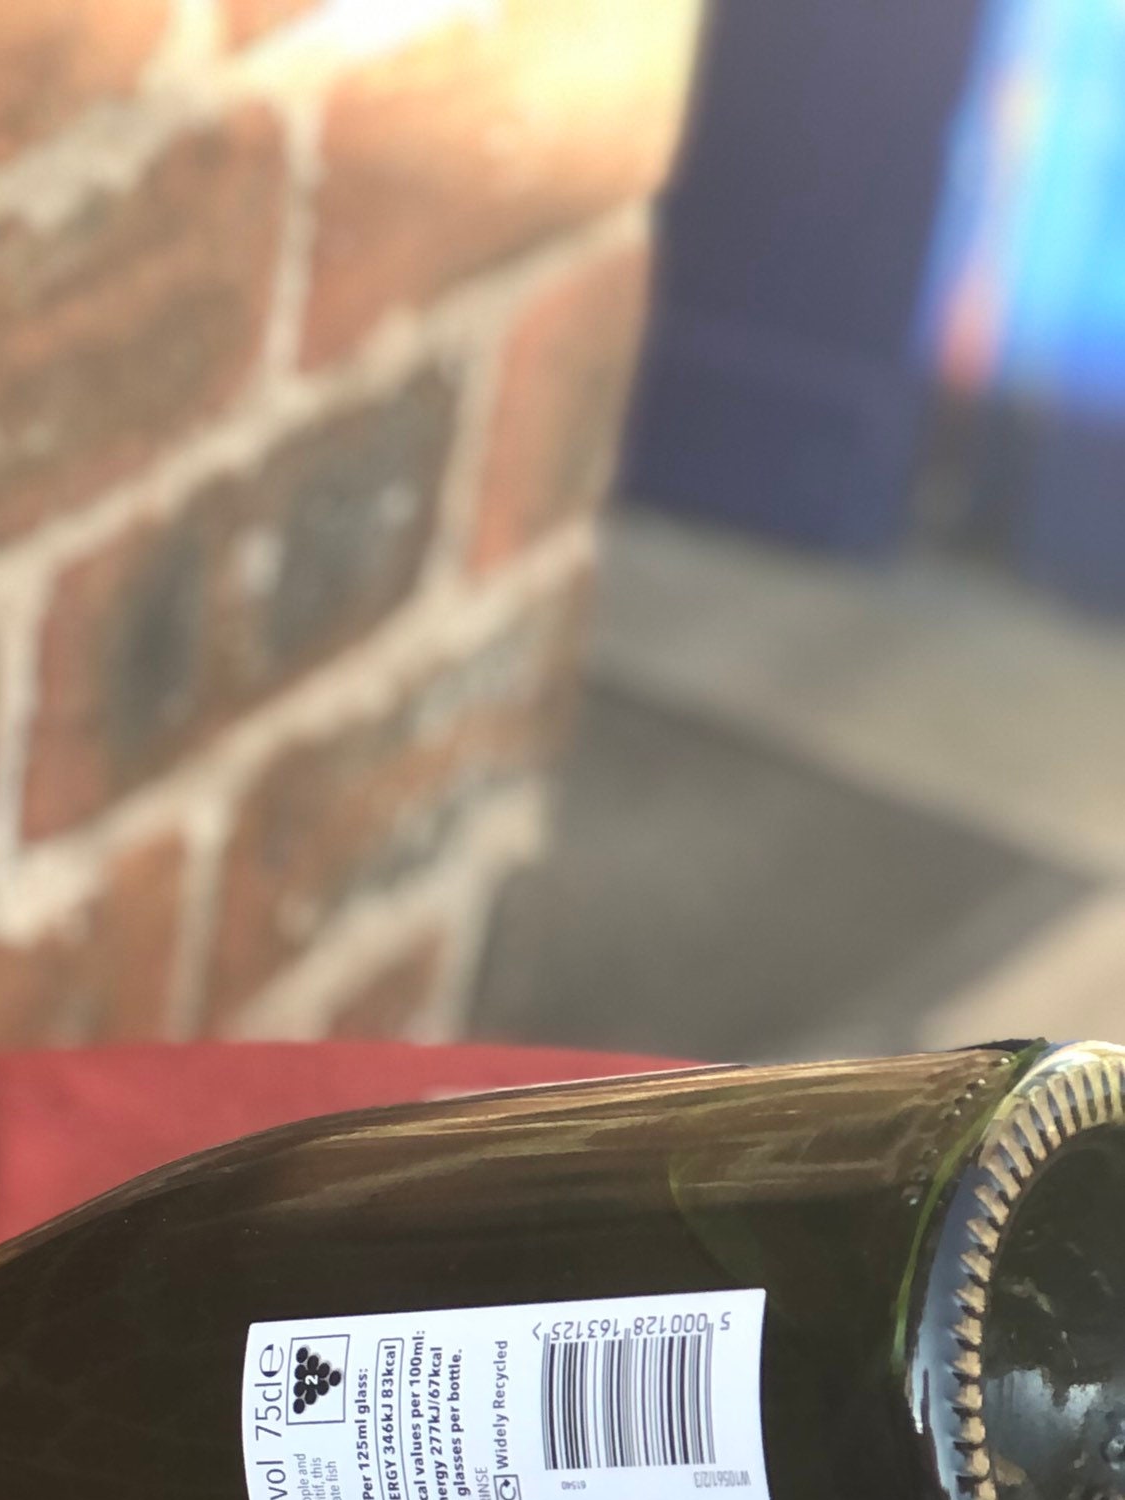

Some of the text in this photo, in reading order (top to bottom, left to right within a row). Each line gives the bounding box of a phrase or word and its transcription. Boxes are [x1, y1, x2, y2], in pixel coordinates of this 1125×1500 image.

[552, 1311, 731, 1341] 5 000128 163125
[306, 1376, 317, 1384] 2
[381, 1345, 396, 1398] 83kcal
[409, 1331, 424, 1386] 100ml:
[447, 1350, 461, 1401] bottle.
[411, 1392, 424, 1418] per
[428, 1347, 442, 1455] 277kJ/67kcal
[450, 1406, 464, 1433] per
[493, 1341, 509, 1469] Widely Recycled
[355, 1369, 374, 1500] Per 125ml glass:
[381, 1404, 395, 1454] 346kJ
[410, 1424, 424, 1475] values
[256, 1460, 287, 1500] vol
[293, 1453, 308, 1475] and
[310, 1457, 323, 1479] this
[325, 1461, 338, 1482] fish
[452, 1438, 471, 1496] glasses
